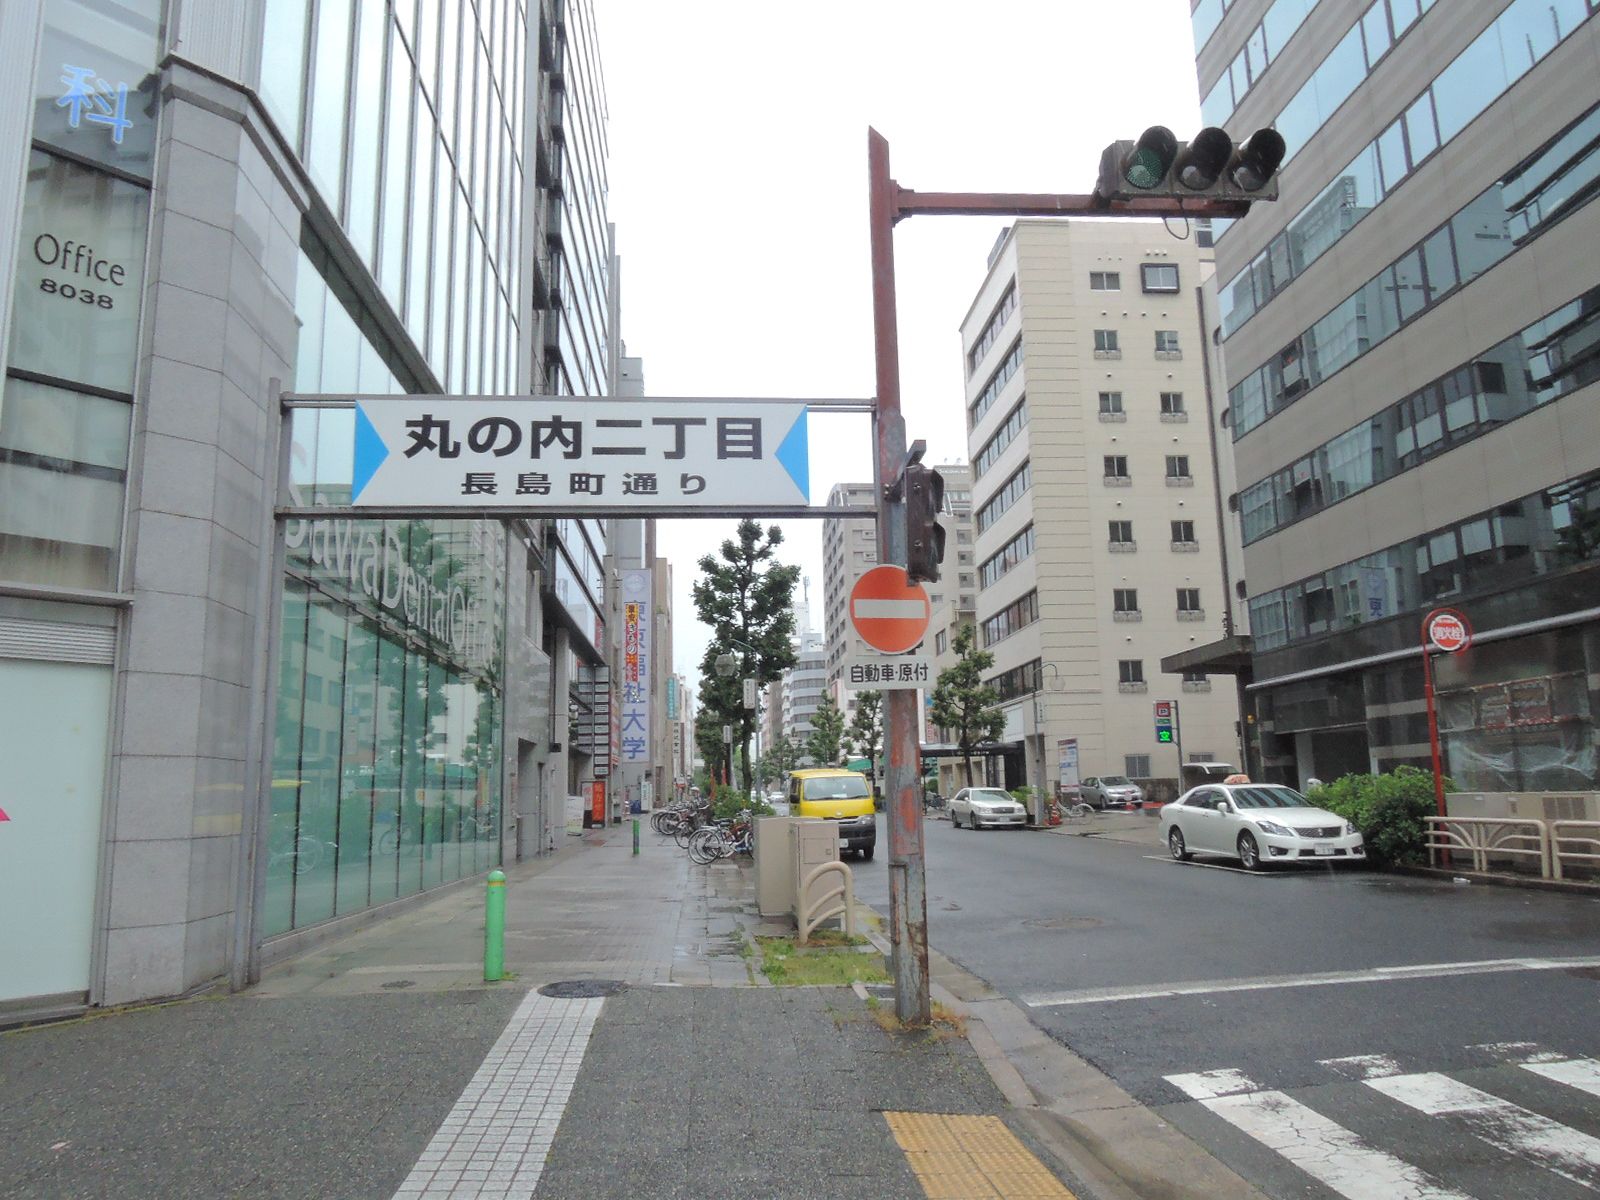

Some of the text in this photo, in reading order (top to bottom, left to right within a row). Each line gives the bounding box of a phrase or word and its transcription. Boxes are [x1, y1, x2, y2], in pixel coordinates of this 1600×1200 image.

[56, 64, 133, 144] 科
[34, 233, 125, 287] Office
[40, 277, 114, 310] 8038
[404, 415, 761, 460] 丸の内二丁目
[461, 472, 706, 496] 長島町通り
